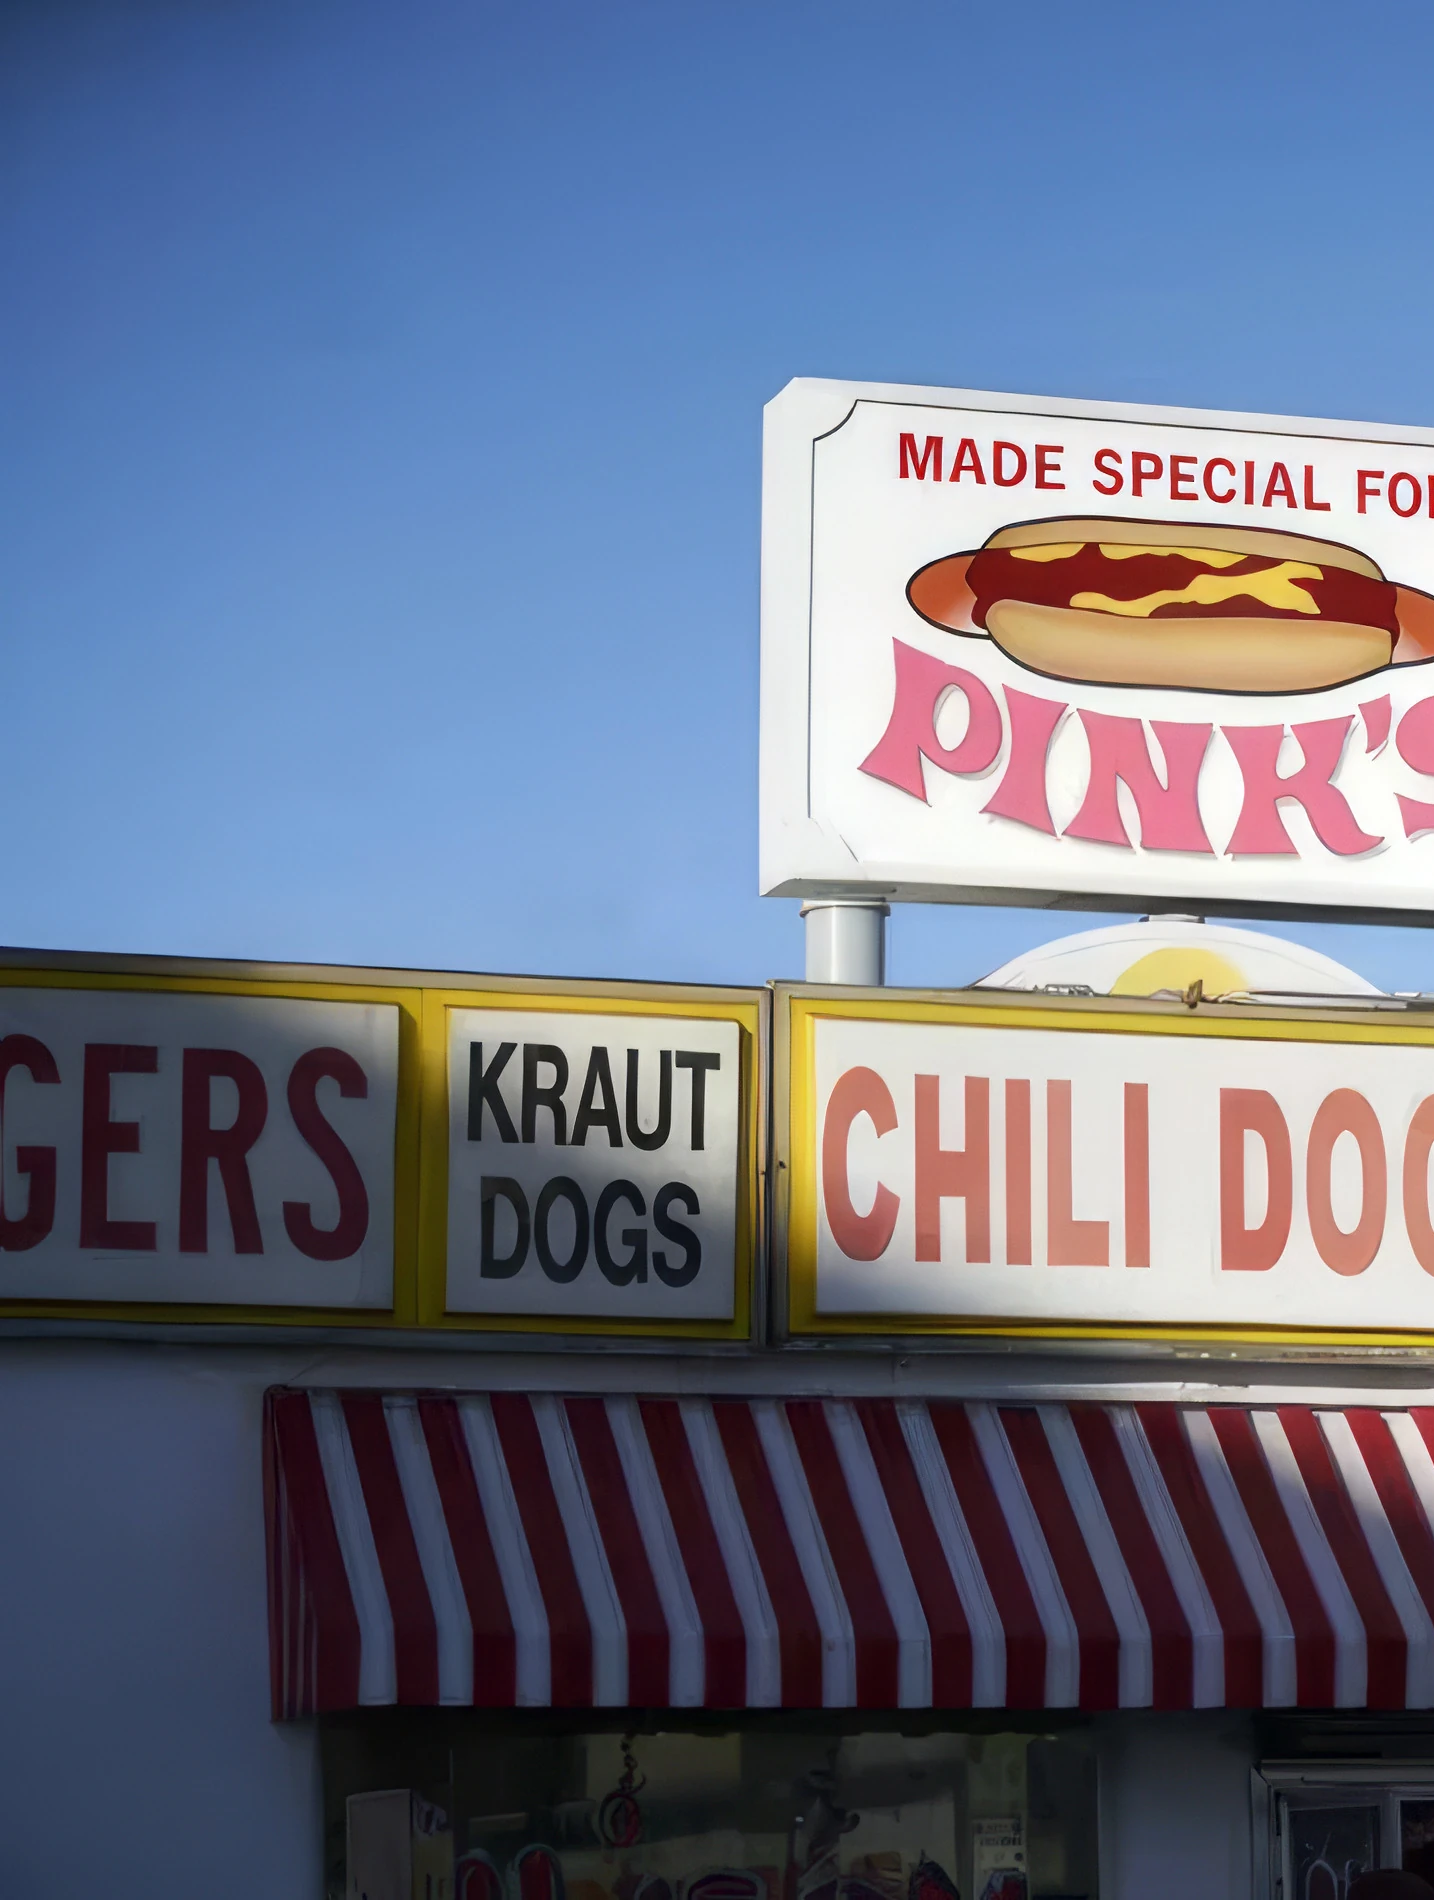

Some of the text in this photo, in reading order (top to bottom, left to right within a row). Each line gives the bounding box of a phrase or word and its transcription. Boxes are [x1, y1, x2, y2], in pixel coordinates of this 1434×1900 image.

[898, 432, 1066, 490] MADE
[1092, 448, 1331, 512] SPECIAL
[0, 1033, 369, 1262] GERS
[467, 1041, 721, 1151] KRAUT
[822, 1065, 1150, 1269] CHILI
[480, 1175, 701, 1288] DOGS
